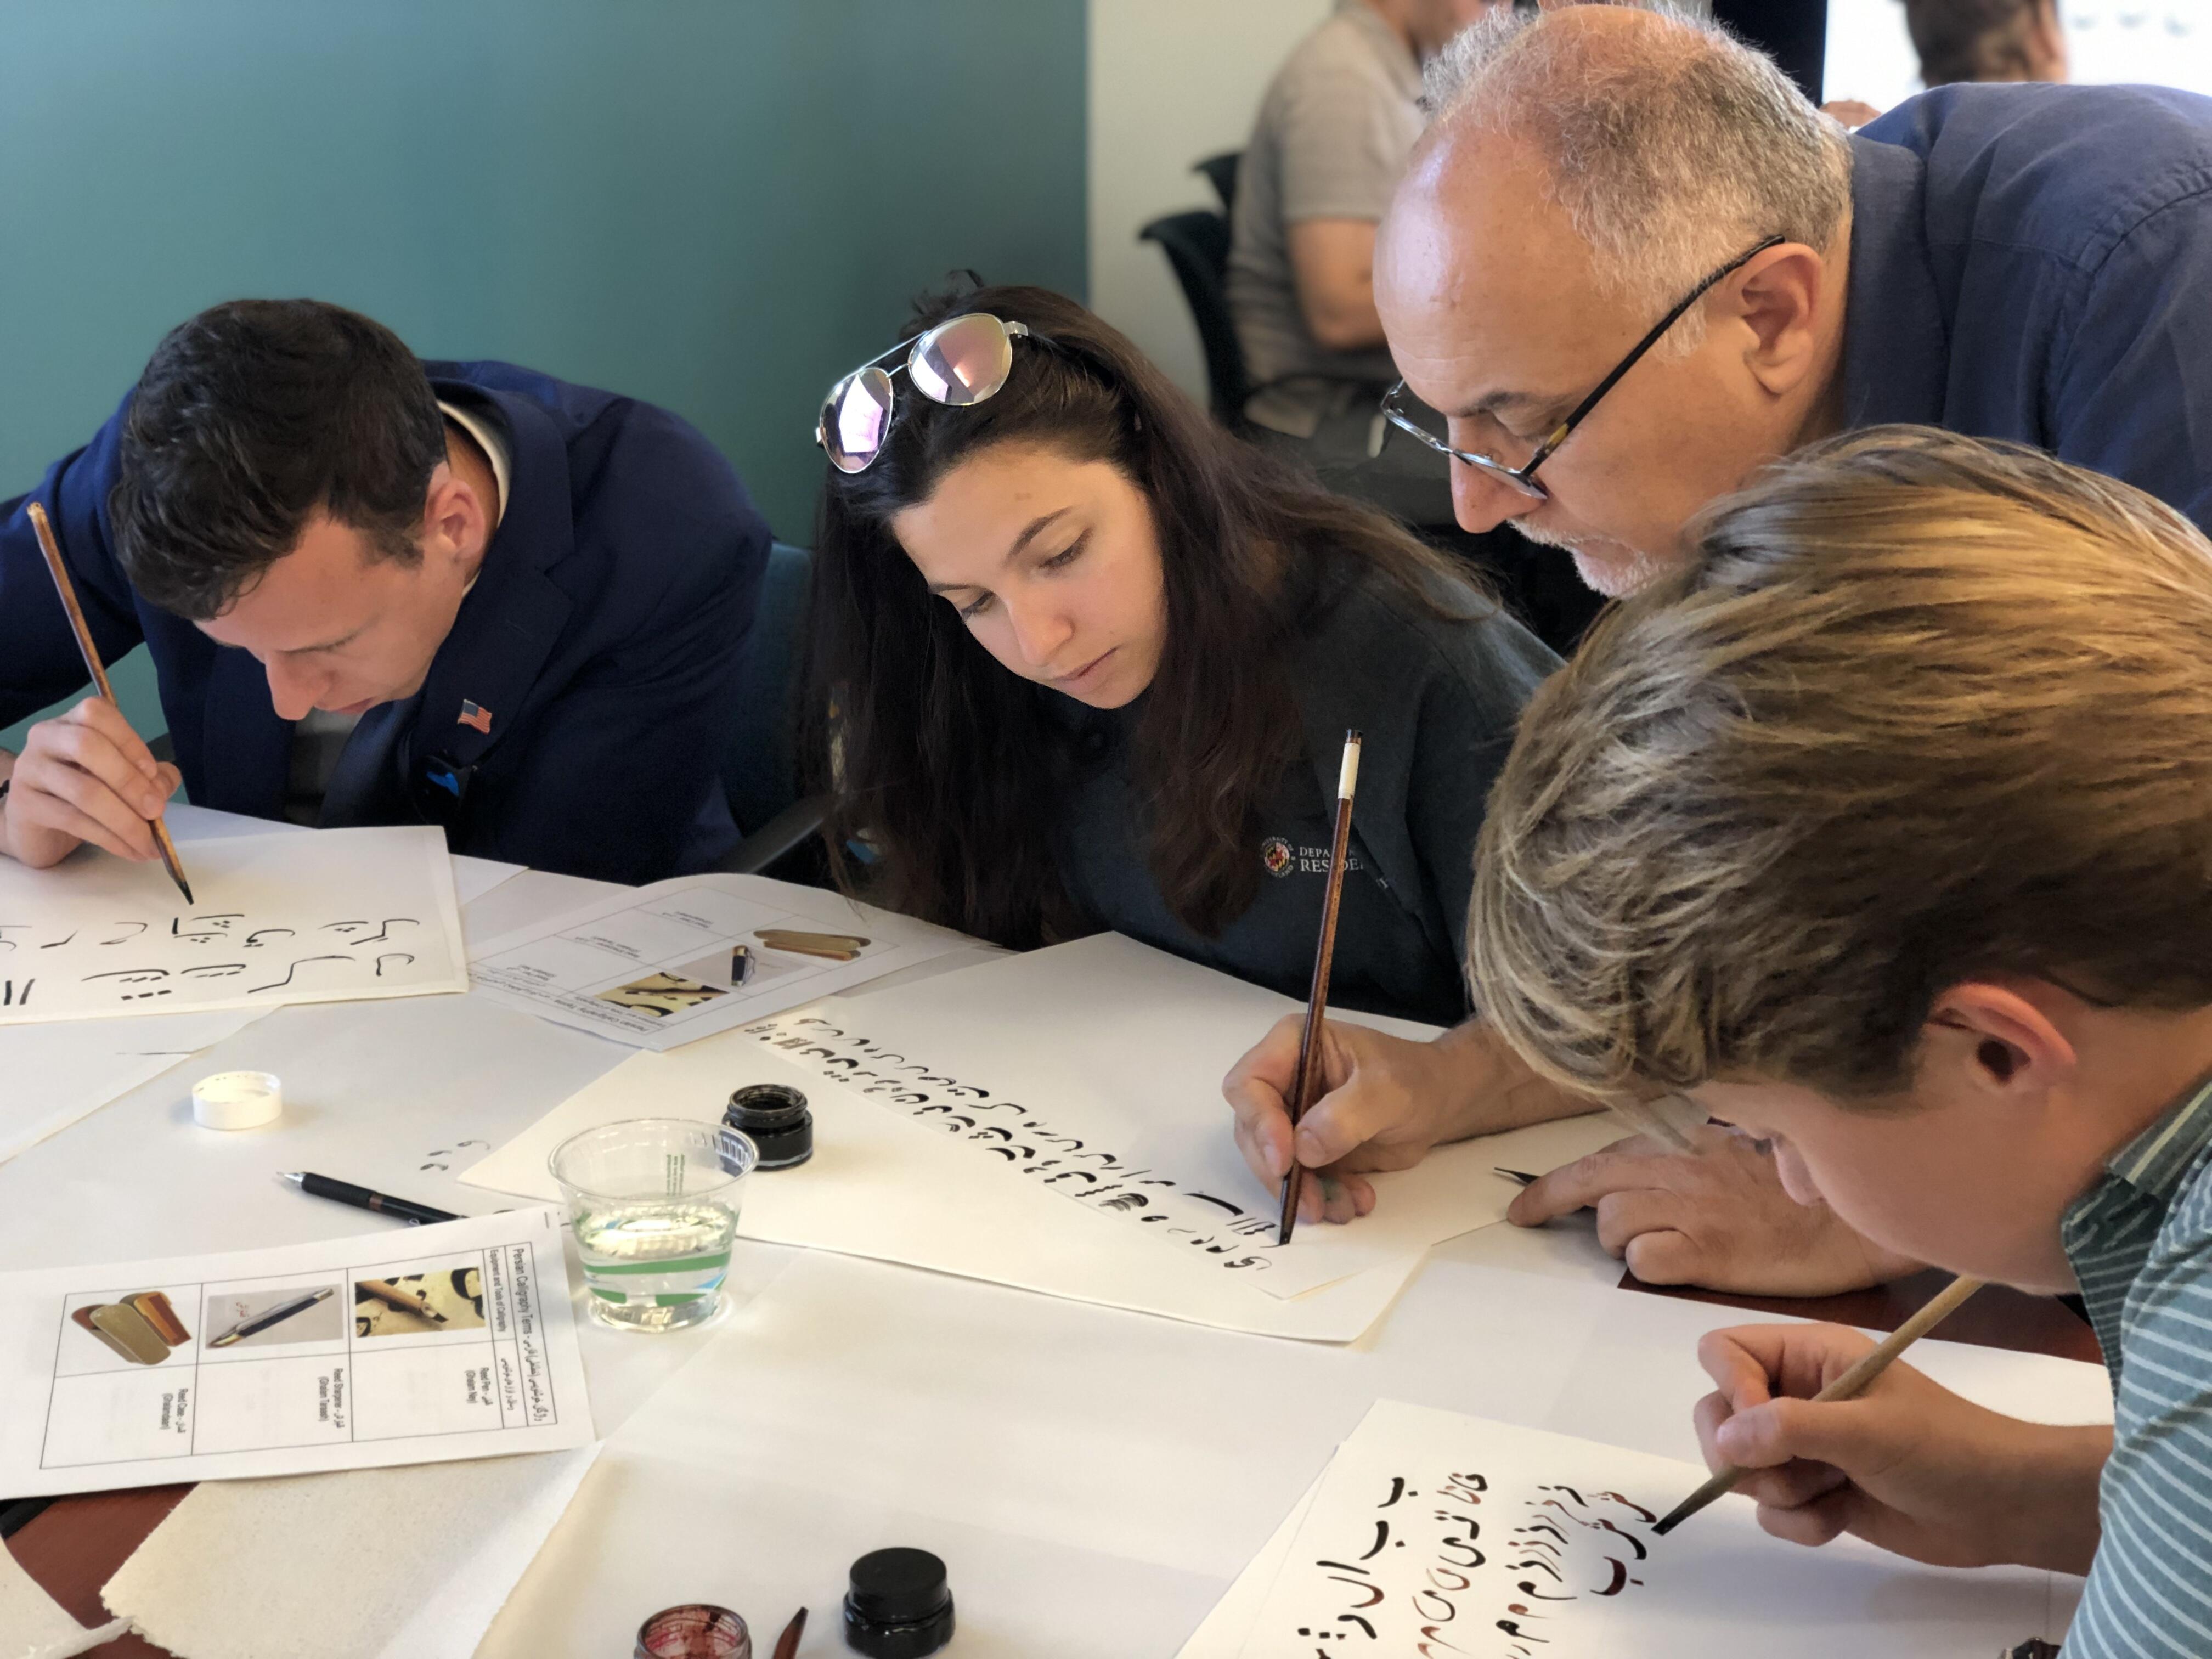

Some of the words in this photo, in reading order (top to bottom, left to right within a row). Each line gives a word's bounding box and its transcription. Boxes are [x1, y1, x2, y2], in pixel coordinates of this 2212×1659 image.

[489, 1249, 501, 1276] Equipment
[512, 1247, 526, 1274] Persian
[493, 1277, 502, 1286] and
[494, 1288, 504, 1301] Tools
[515, 1276, 531, 1313] Calligraphy
[495, 1307, 508, 1333] Calligraphy
[521, 1314, 534, 1335] Terms
[333, 1368, 344, 1383] Reed
[480, 1367, 490, 1380] Reed
[332, 1383, 344, 1409] Sharpener
[482, 1381, 492, 1391] Pen
